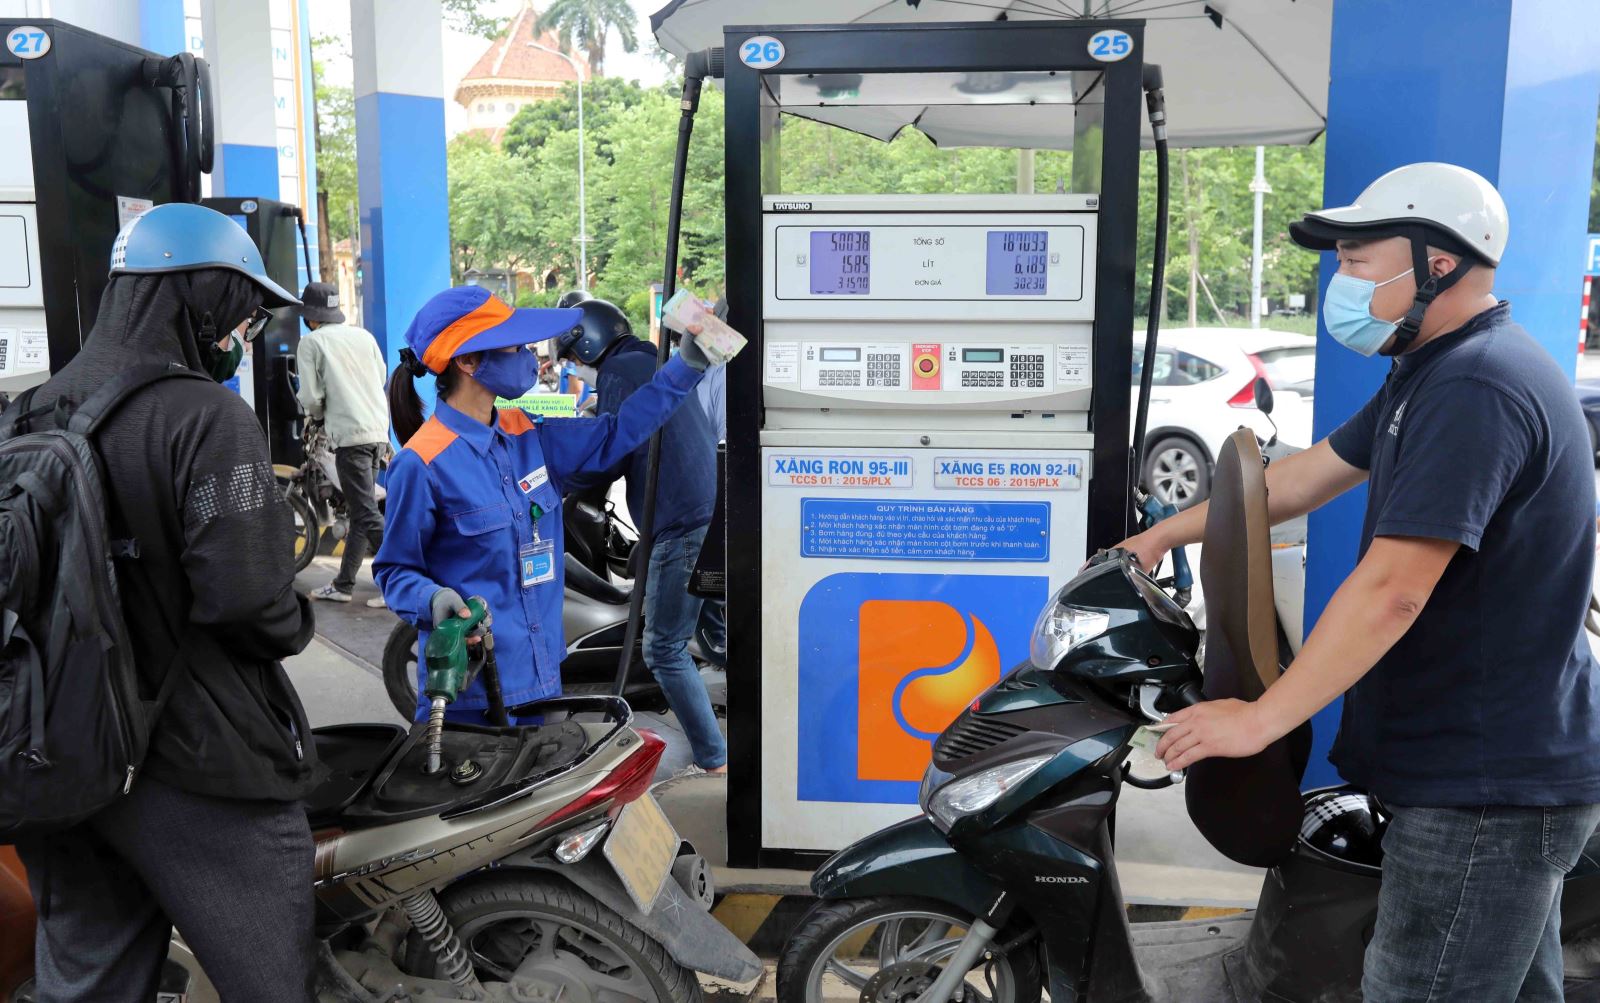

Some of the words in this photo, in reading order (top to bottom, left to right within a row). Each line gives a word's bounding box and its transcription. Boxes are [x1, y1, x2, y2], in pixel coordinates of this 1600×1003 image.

[12, 33, 45, 52] 27
[1093, 35, 1129, 55] 25
[744, 41, 780, 62] 26
[243, 203, 256, 211] 29
[831, 232, 869, 252] 50038
[913, 237, 933, 246] TỔNG
[935, 237, 945, 246] SỐ
[922, 259, 935, 268] LÍT
[775, 457, 823, 474] XĂNG
[828, 460, 864, 475] RON
[868, 461, 908, 475] 95-III
[940, 460, 983, 475] XĂNG
[988, 463, 1005, 475] E5
[1010, 463, 1040, 475] RON
[1045, 464, 1076, 476] 92-II
[789, 475, 817, 484] TCCS
[821, 476, 832, 484] 01
[842, 476, 891, 486] 2015/PLX
[955, 477, 984, 486] TCCS
[987, 477, 1000, 486] 06
[1009, 478, 1059, 487] 2015/PLX
[897, 504, 925, 513] TRÌNH
[927, 505, 946, 513] BÁN
[948, 505, 975, 513] HÀNG
[1034, 876, 1090, 884] HONDA
